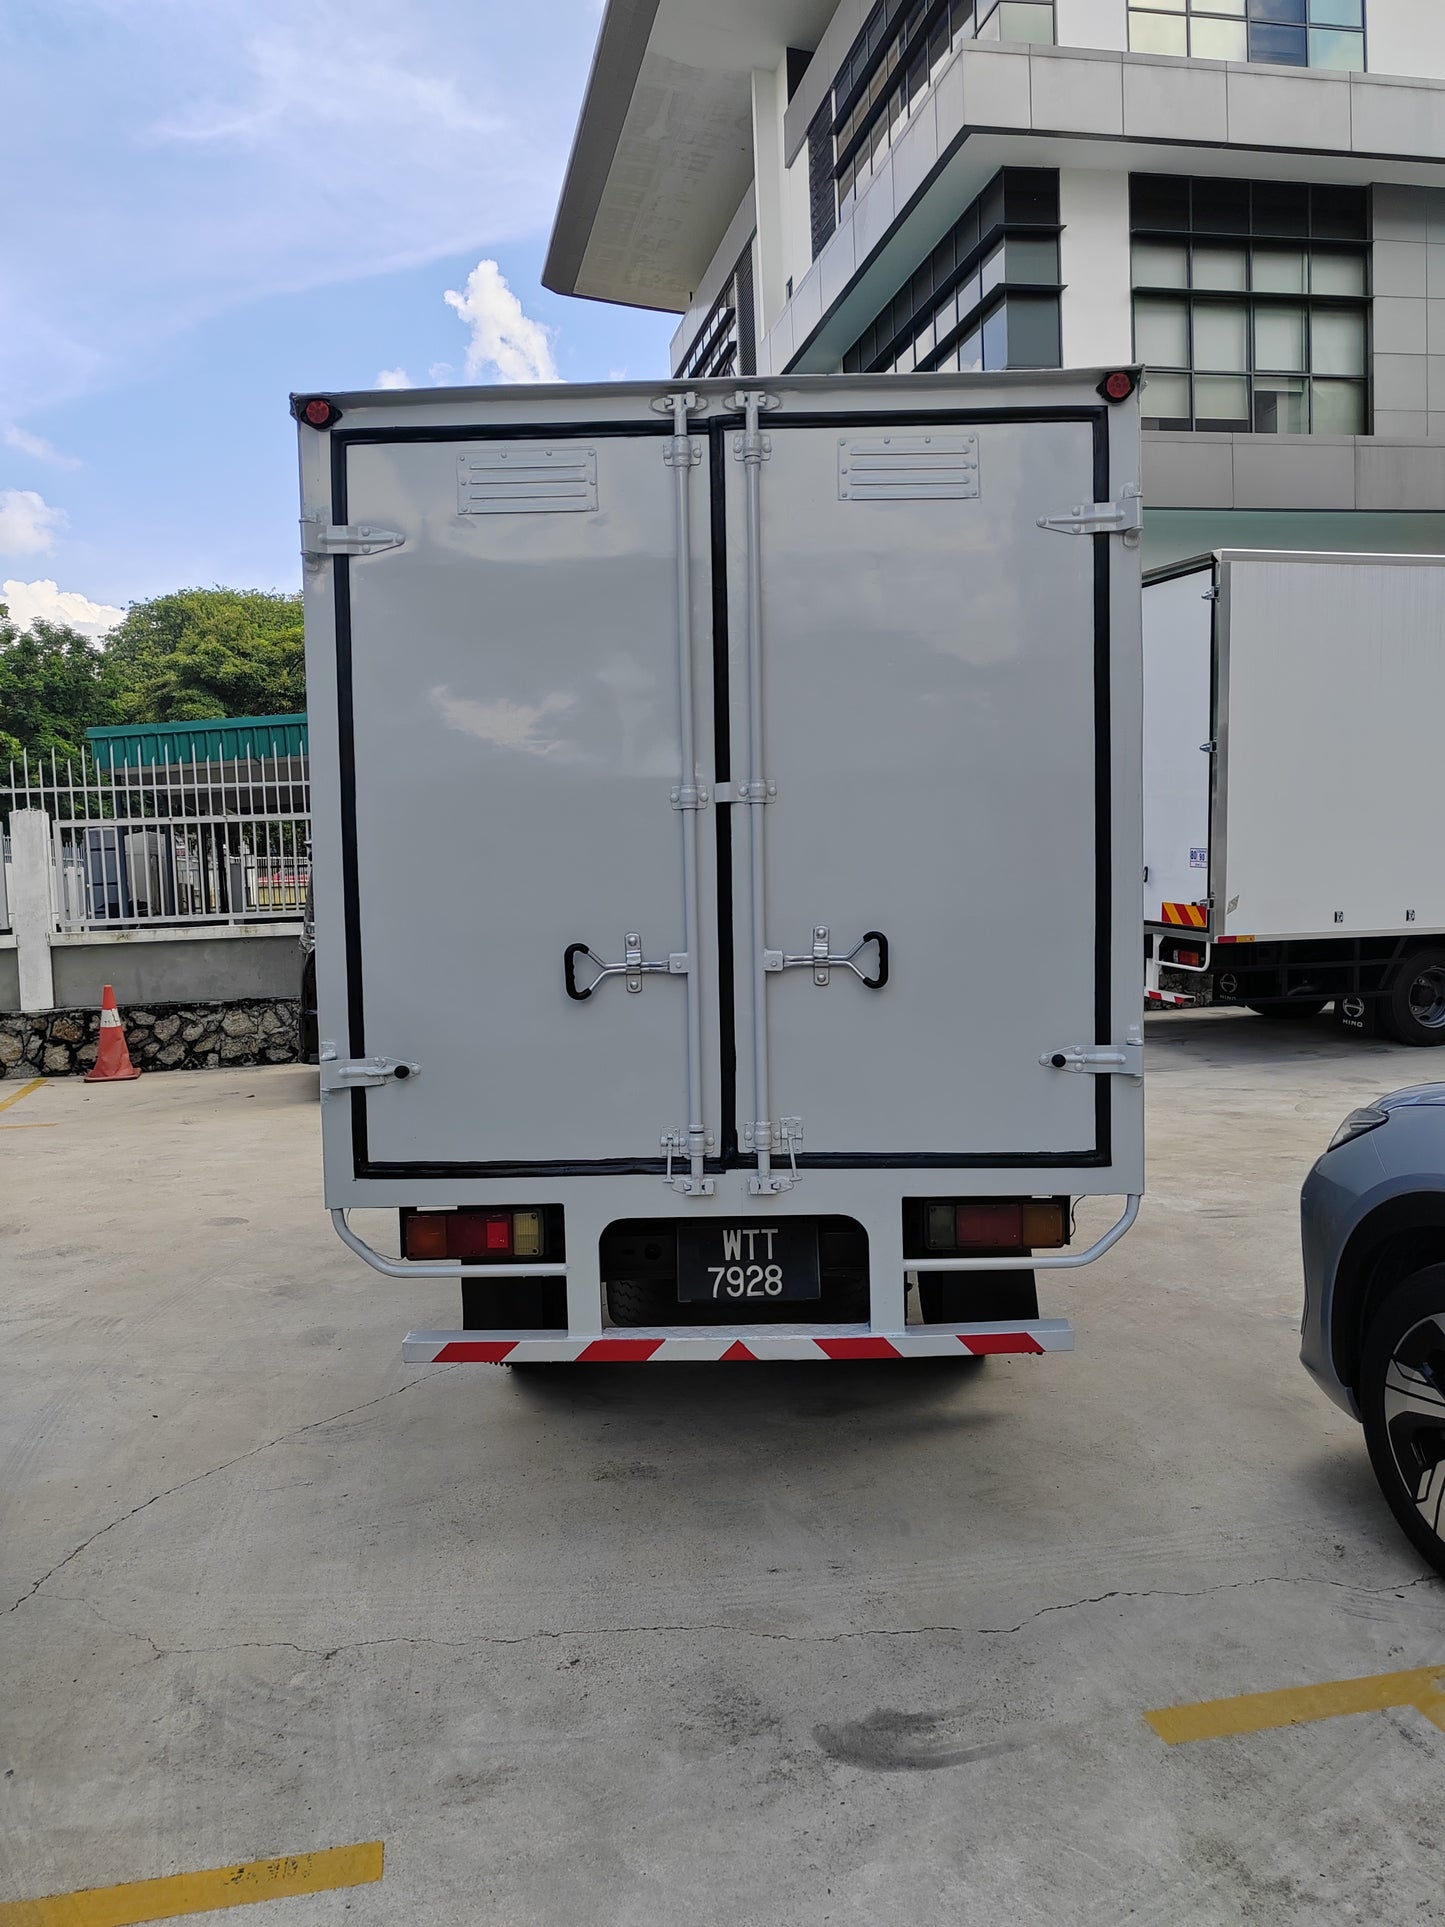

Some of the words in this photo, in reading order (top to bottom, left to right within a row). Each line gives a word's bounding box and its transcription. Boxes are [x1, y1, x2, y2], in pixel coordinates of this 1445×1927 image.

[1342, 1018, 1363, 1028] HINO
[722, 1228, 778, 1260] WTT
[707, 1264, 783, 1299] 7928
